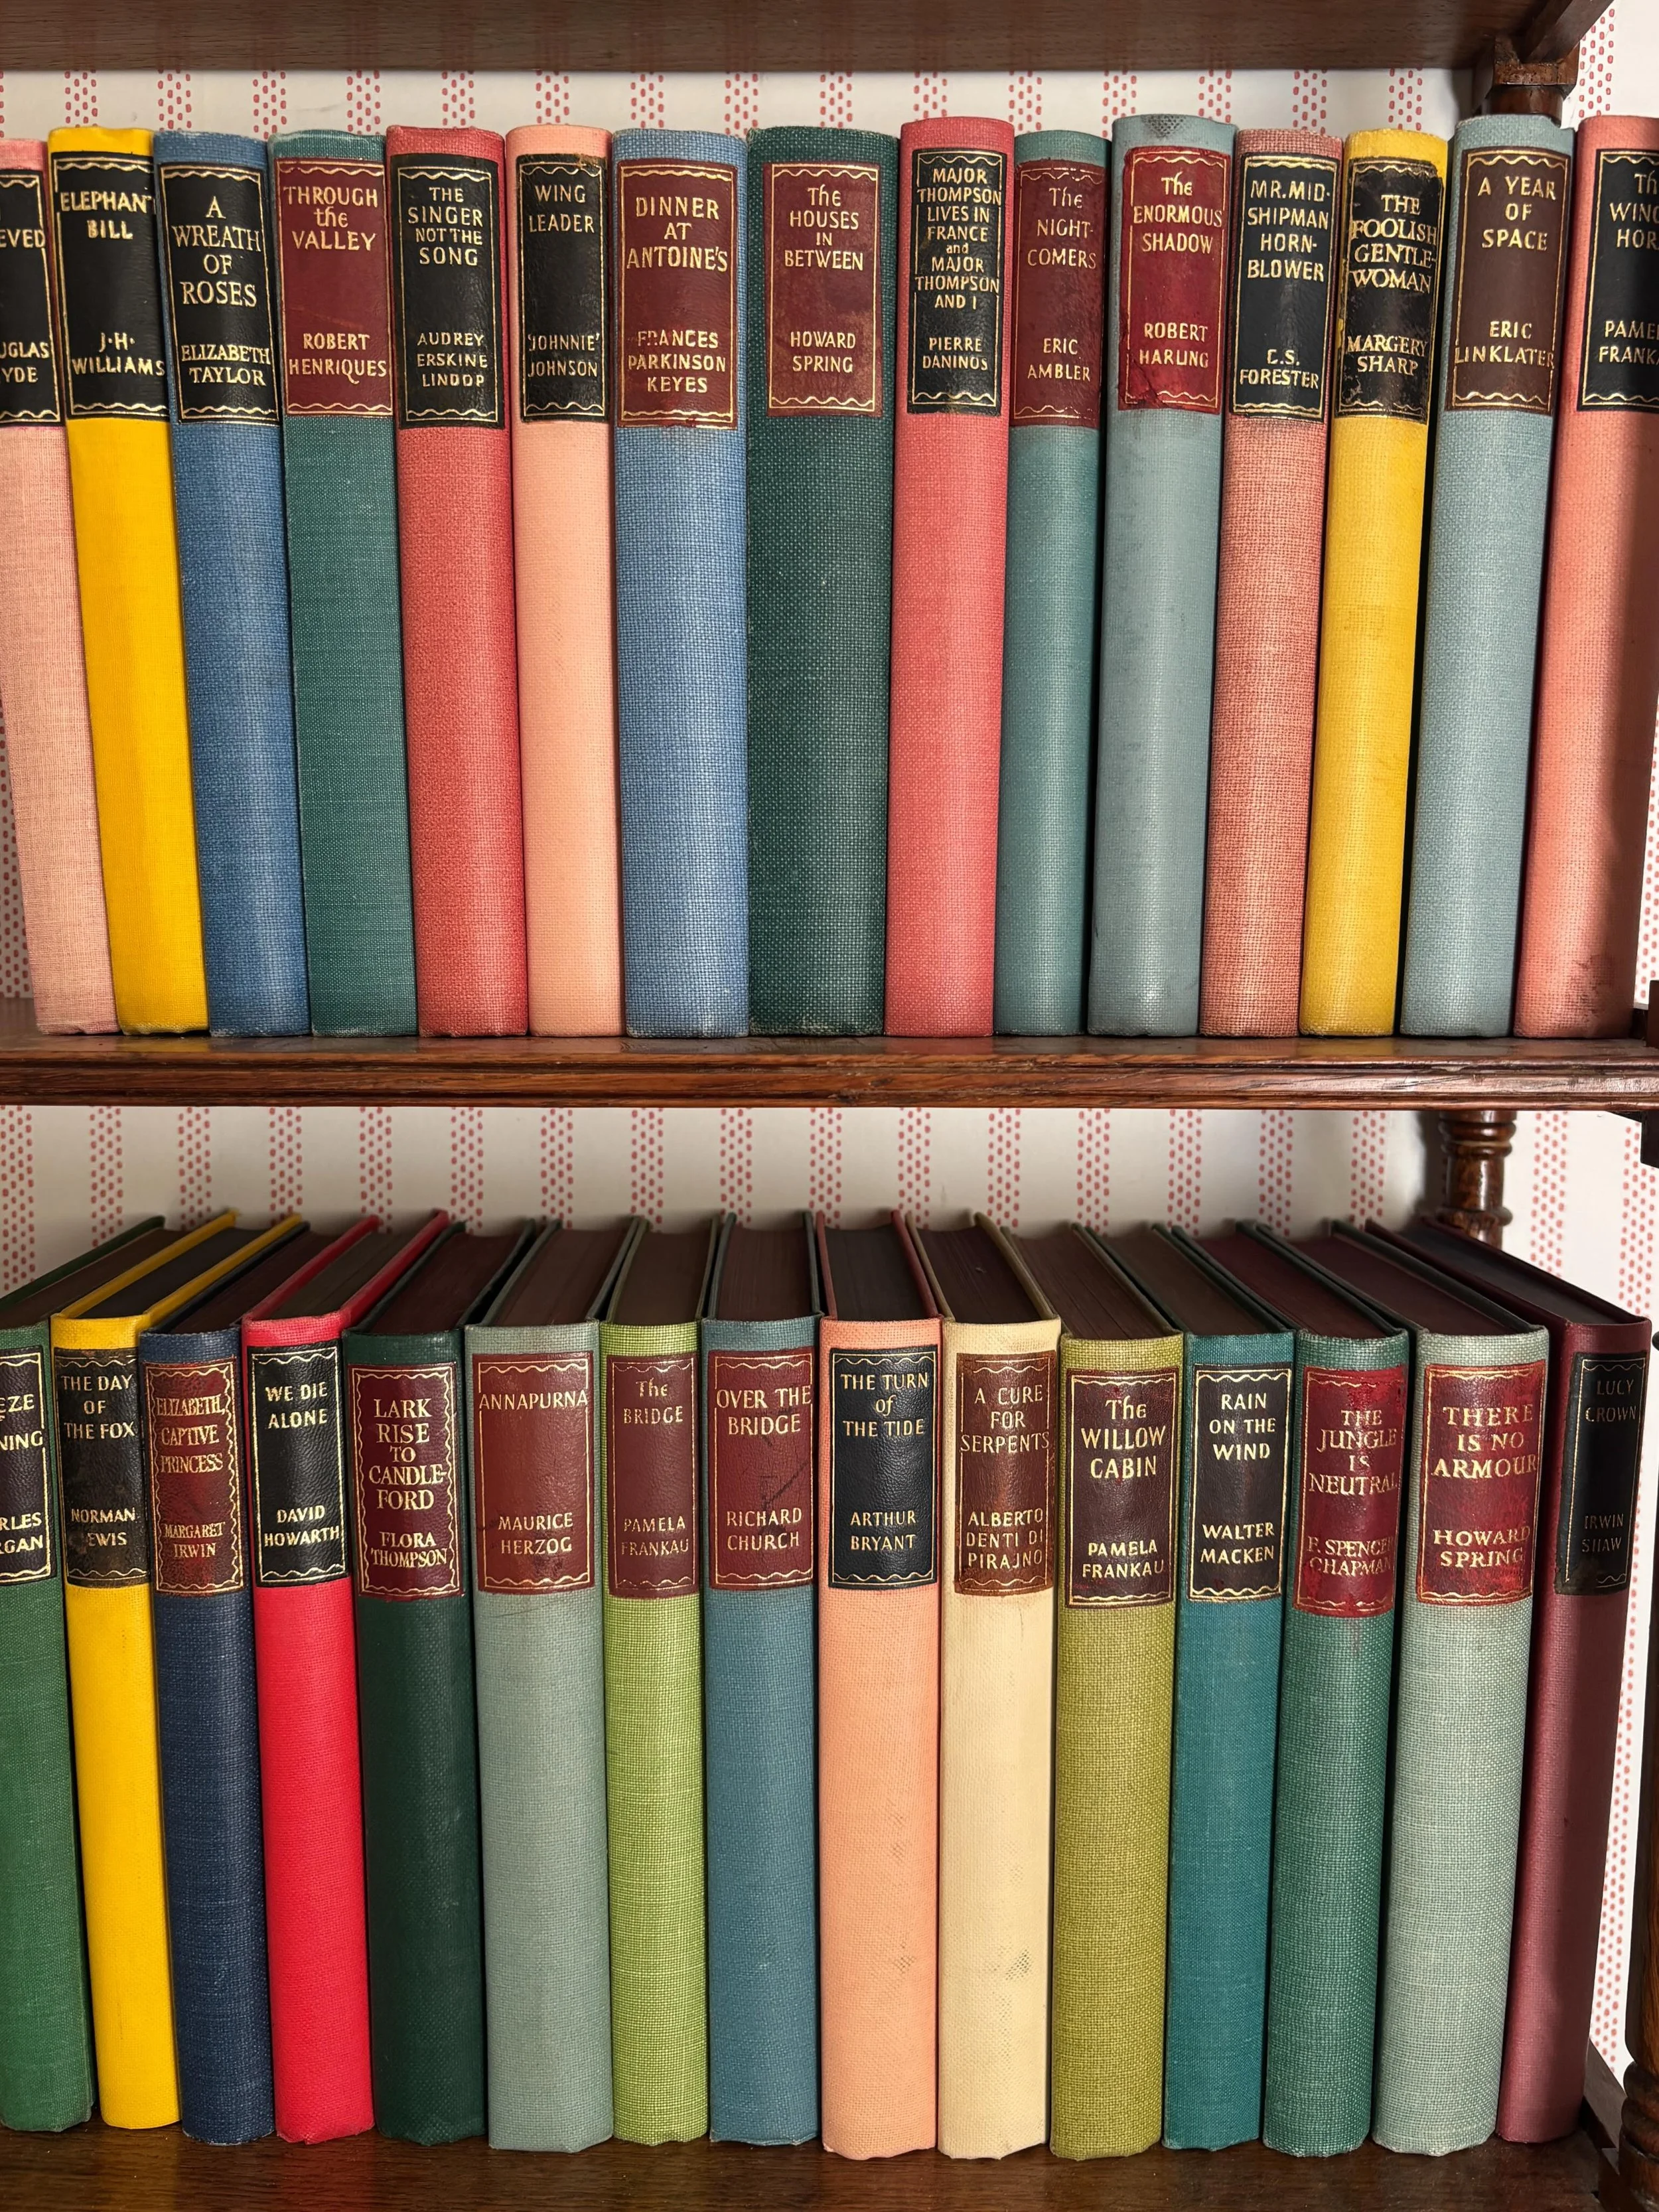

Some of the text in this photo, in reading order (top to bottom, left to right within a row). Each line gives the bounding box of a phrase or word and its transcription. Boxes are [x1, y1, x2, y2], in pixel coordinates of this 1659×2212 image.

[932, 167, 987, 184] MAJOR
[1161, 171, 1192, 196] The
[283, 186, 378, 208] THROUGH
[429, 187, 464, 202] THE
[535, 184, 586, 203] WING
[808, 184, 841, 206] The
[917, 188, 1002, 206] THOMPSON
[1048, 186, 1083, 208] The
[1478, 176, 1556, 200] A YEAR
[206, 196, 226, 219] A
[636, 196, 719, 220] DINNER
[1381, 194, 1421, 216] THE
[1505, 203, 1532, 221] OF
[314, 206, 348, 228] the
[407, 207, 483, 227] SINGER
[529, 214, 595, 234] LEADER
[790, 210, 859, 230] HOUSES
[928, 207, 990, 223] LIVES IN
[1133, 205, 1223, 228] ENORMOUS
[1247, 207, 1329, 230] SHIPMAN
[87, 220, 133, 240] BILL
[172, 226, 262, 252] WREATH
[415, 228, 482, 245] NOT THE
[664, 222, 692, 240] AT
[816, 232, 832, 246] IN
[927, 226, 988, 242] FRANCE
[1352, 218, 1437, 247] FOOLISH
[292, 231, 377, 251] VALLEY
[946, 244, 969, 254] and
[1142, 233, 1214, 254] SHADOW
[1261, 233, 1317, 253] HORN-
[1482, 229, 1548, 251] SPACE
[203, 255, 233, 275] OF
[419, 247, 478, 265] SONG
[784, 251, 863, 271] BETWEEN
[931, 257, 984, 272] MAJOR
[1027, 248, 1096, 269] COMERS
[1354, 243, 1437, 269] GENTLE-
[1247, 259, 1325, 282] BLOWER
[915, 277, 999, 293] THOMPSON
[1350, 269, 1431, 295] WOMAN
[180, 281, 257, 308] ROSES
[934, 295, 977, 309] AND I
[417, 332, 484, 346] AUDREY
[637, 330, 719, 349] FRANCES
[1144, 323, 1208, 342] ROBERT
[1489, 321, 1532, 340] ERIC
[303, 333, 370, 350] ROBERT
[790, 332, 856, 349] HOWARD
[929, 337, 983, 352] PIERRE
[1043, 338, 1078, 355] ERIC
[1346, 334, 1428, 357] MARGERY
[181, 344, 271, 365] ELIZABETH
[417, 353, 488, 368] ERSKINE
[628, 354, 726, 372] PARKINSON
[922, 356, 988, 371] DANINOS
[1267, 349, 1299, 366] C.S.
[1455, 346, 1555, 370] LINKLATER
[72, 357, 165, 376] WILLIAMS
[289, 358, 387, 384] HENRIQUES
[528, 361, 597, 378] JOHNSON
[792, 356, 853, 373] SPRING
[1027, 364, 1091, 382] AMBLER
[1357, 356, 1419, 376] SHARP
[189, 368, 266, 386] TAYLOR
[647, 377, 708, 393] KEYES
[1240, 369, 1319, 389] FORESTER
[61, 1374, 133, 1392] THE DAY
[635, 1378, 668, 1398] The
[840, 1372, 928, 1390] THE TURN
[1596, 1379, 1634, 1395] LUCY
[265, 1381, 328, 1402] WE DIE
[479, 1390, 588, 1410] ANNAPURNA
[717, 1385, 812, 1409] OVER THE
[974, 1384, 1043, 1404] A CURE
[84, 1400, 107, 1415] OF
[374, 1398, 432, 1419] LARK
[1105, 1396, 1147, 1420] The
[1220, 1393, 1266, 1411] RAIN
[268, 1409, 327, 1429] ALONE
[624, 1406, 684, 1424] BRIDGE
[991, 1410, 1025, 1430] FOR
[1341, 1410, 1382, 1426] THE
[1442, 1403, 1534, 1428] THERE
[1585, 1406, 1636, 1422] CROWN
[64, 1422, 137, 1439] THE FOX
[376, 1423, 430, 1445] RISE
[729, 1414, 801, 1436] BRIDGE
[843, 1418, 925, 1437] THE TIDE
[1209, 1418, 1276, 1434] ON THE
[161, 1424, 220, 1446] CAPTIVE
[960, 1432, 1050, 1453] SERPENTS
[1081, 1425, 1166, 1450] WILLOW
[1316, 1428, 1398, 1453] JUNGLE
[1457, 1432, 1524, 1452] IS NO
[390, 1447, 416, 1463] TO
[1213, 1443, 1270, 1461] WIND
[160, 1452, 224, 1474] PRINCESS
[1090, 1455, 1157, 1479] CABIN
[1348, 1455, 1370, 1473] IS
[1431, 1454, 1537, 1479] ARMOUR
[377, 1489, 435, 1510] FORD
[71, 1507, 136, 1524] NORMAN
[276, 1505, 325, 1523] DAVID
[498, 1512, 573, 1531] MAURICE
[727, 1508, 802, 1526] RICHARD
[850, 1510, 916, 1525] ARTHUR
[968, 1508, 1043, 1526] ALBERTO
[1584, 1513, 1624, 1530] IRWIN
[163, 1522, 226, 1539] MARGARET
[624, 1516, 686, 1532] PAMELA
[1202, 1522, 1274, 1540] WALTER
[264, 1525, 340, 1546] HOWARTH
[380, 1532, 436, 1548] FLORA
[727, 1531, 800, 1551] CHURCH
[851, 1534, 916, 1551] BRYANT
[966, 1528, 1043, 1548] DENTI DI
[1433, 1526, 1530, 1546] HOWARD
[173, 1542, 217, 1559] IRWIN
[501, 1537, 573, 1555] HERZOG
[621, 1538, 689, 1556] FRANKAU
[1088, 1539, 1157, 1557] PAMELA
[1200, 1545, 1274, 1564] MACKEN
[371, 1548, 448, 1568] THOMPSON
[968, 1549, 1043, 1570] PIRAJNO
[1439, 1546, 1524, 1568] SPRING
[1082, 1560, 1165, 1579] FRANKAU
